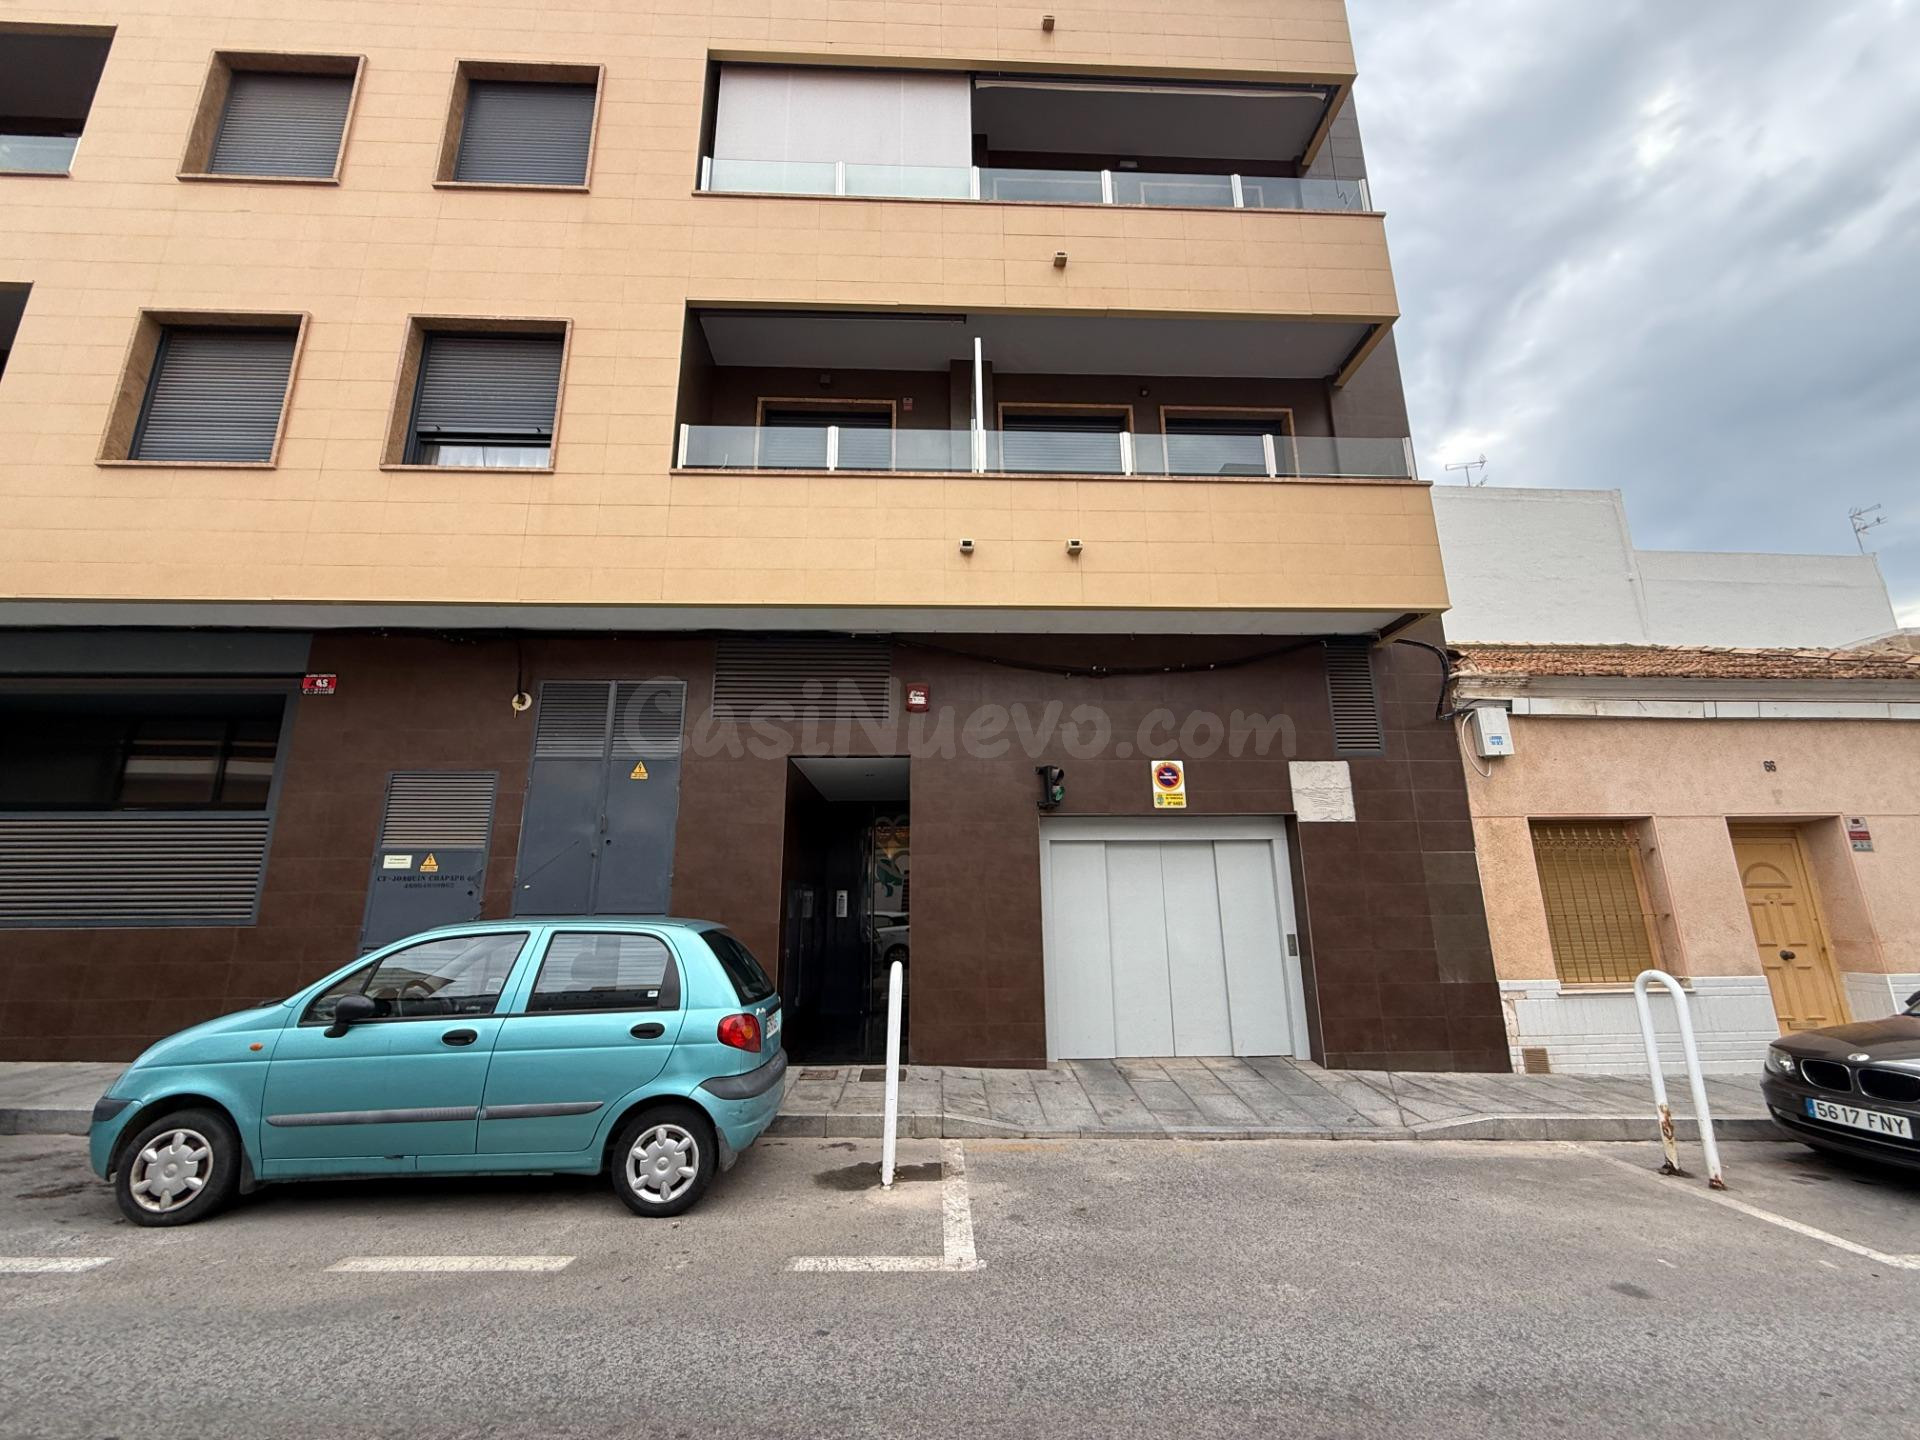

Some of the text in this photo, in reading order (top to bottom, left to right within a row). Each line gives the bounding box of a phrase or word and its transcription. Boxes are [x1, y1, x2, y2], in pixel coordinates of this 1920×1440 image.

[1763, 760, 1776, 772] 66
[1816, 1102, 1904, 1134] 5617 FNY
